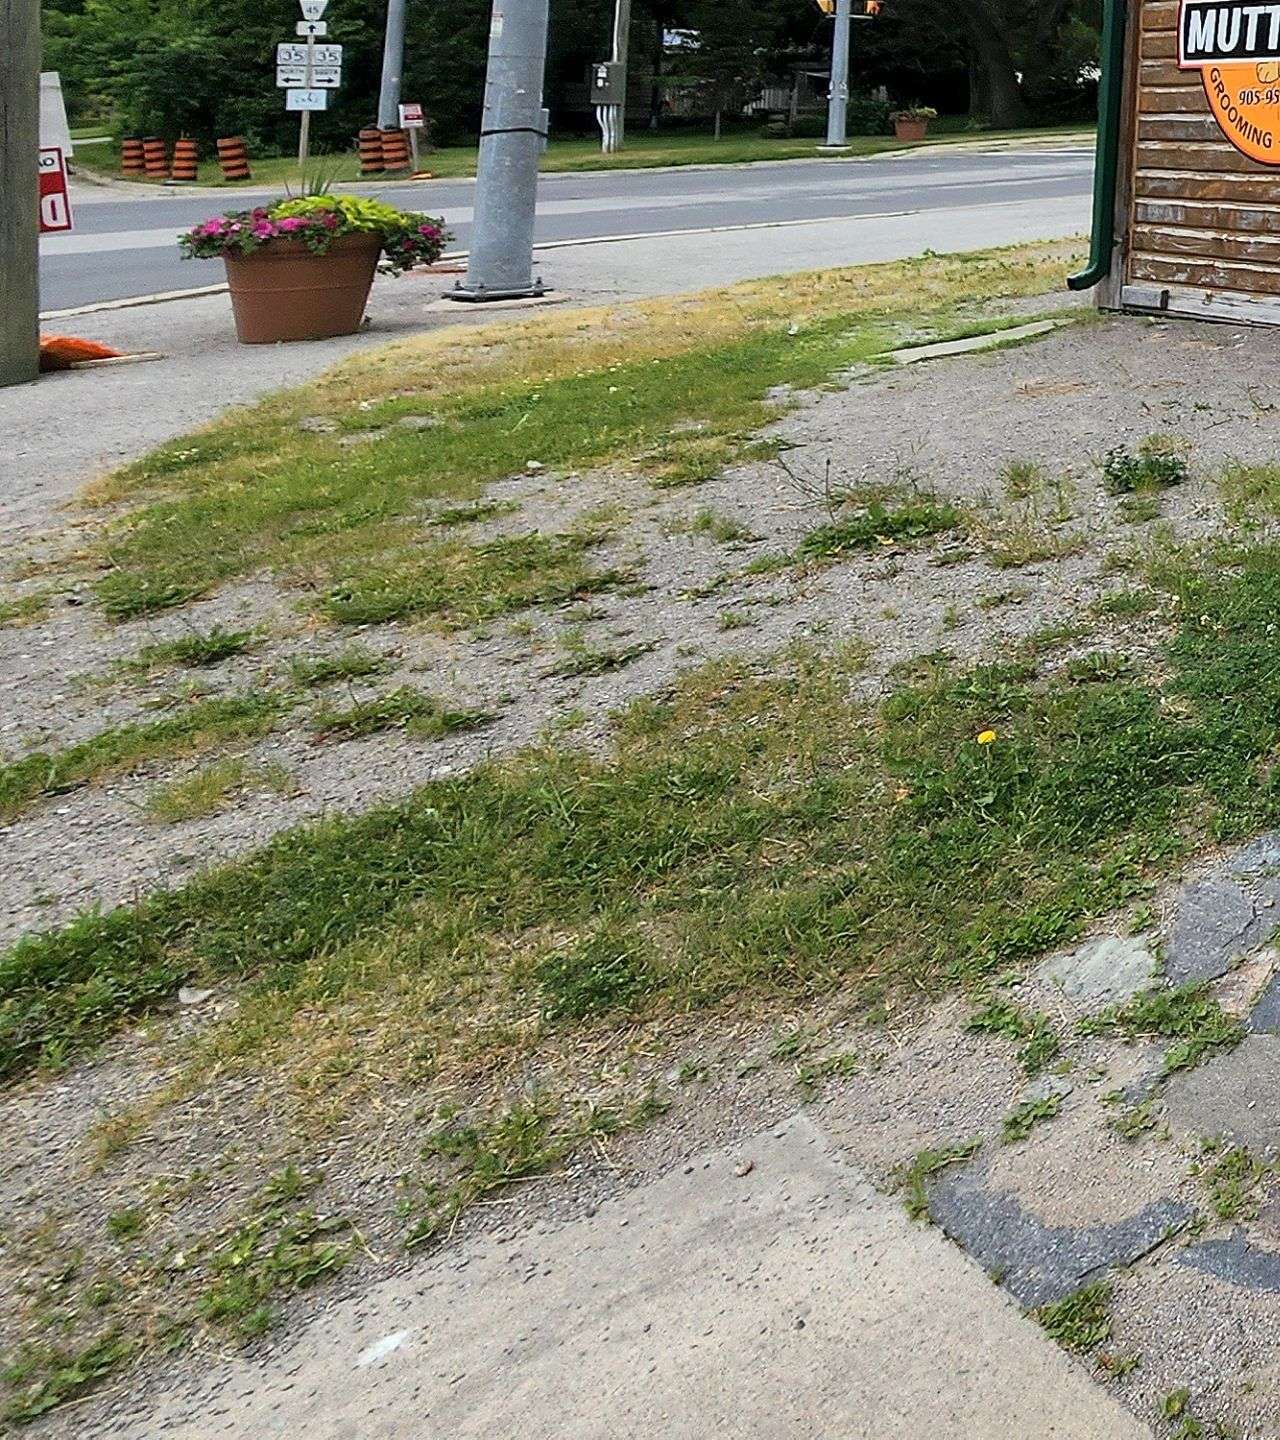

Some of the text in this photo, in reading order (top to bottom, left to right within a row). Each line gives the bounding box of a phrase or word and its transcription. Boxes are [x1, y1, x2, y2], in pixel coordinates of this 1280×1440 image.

[282, 50, 304, 61] 35
[316, 51, 338, 62] 35
[1210, 67, 1273, 149] GROOMING
